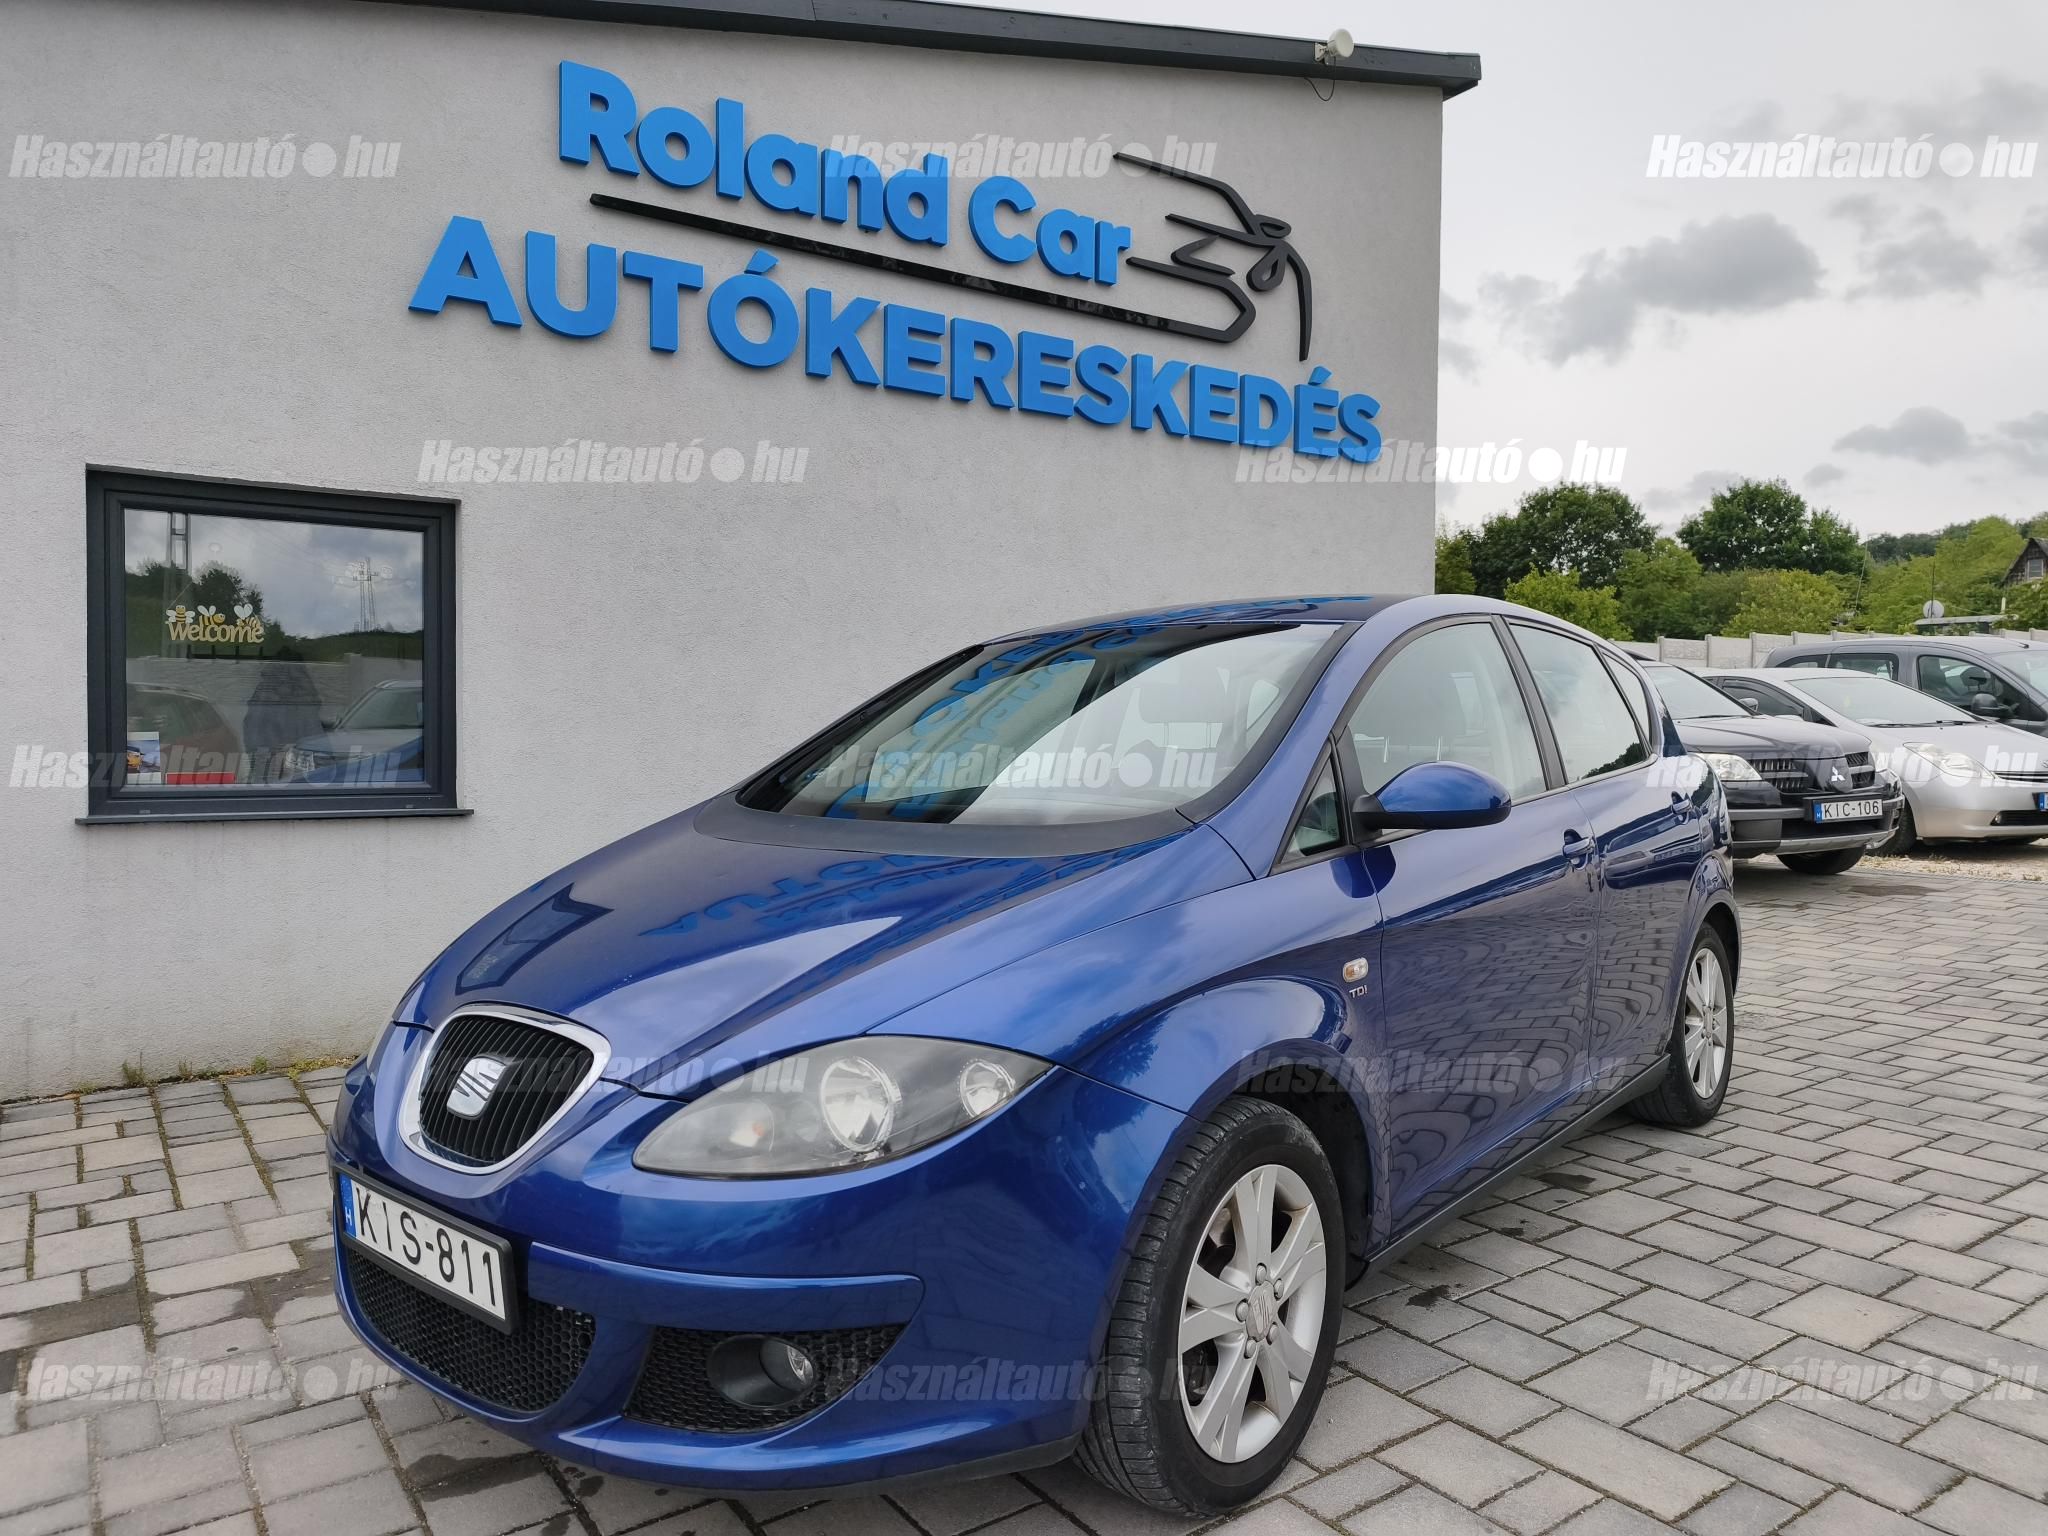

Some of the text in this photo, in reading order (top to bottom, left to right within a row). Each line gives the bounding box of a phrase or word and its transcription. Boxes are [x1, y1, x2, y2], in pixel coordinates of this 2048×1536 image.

[559, 60, 1131, 286] Roland Car
[408, 215, 1382, 464] AUTÓKERESKEDÉS
[165, 614, 265, 643] Welcome
[1823, 801, 1880, 819] KIC-106
[1349, 985, 1368, 998] TDI
[356, 1187, 496, 1307] KIS-811
